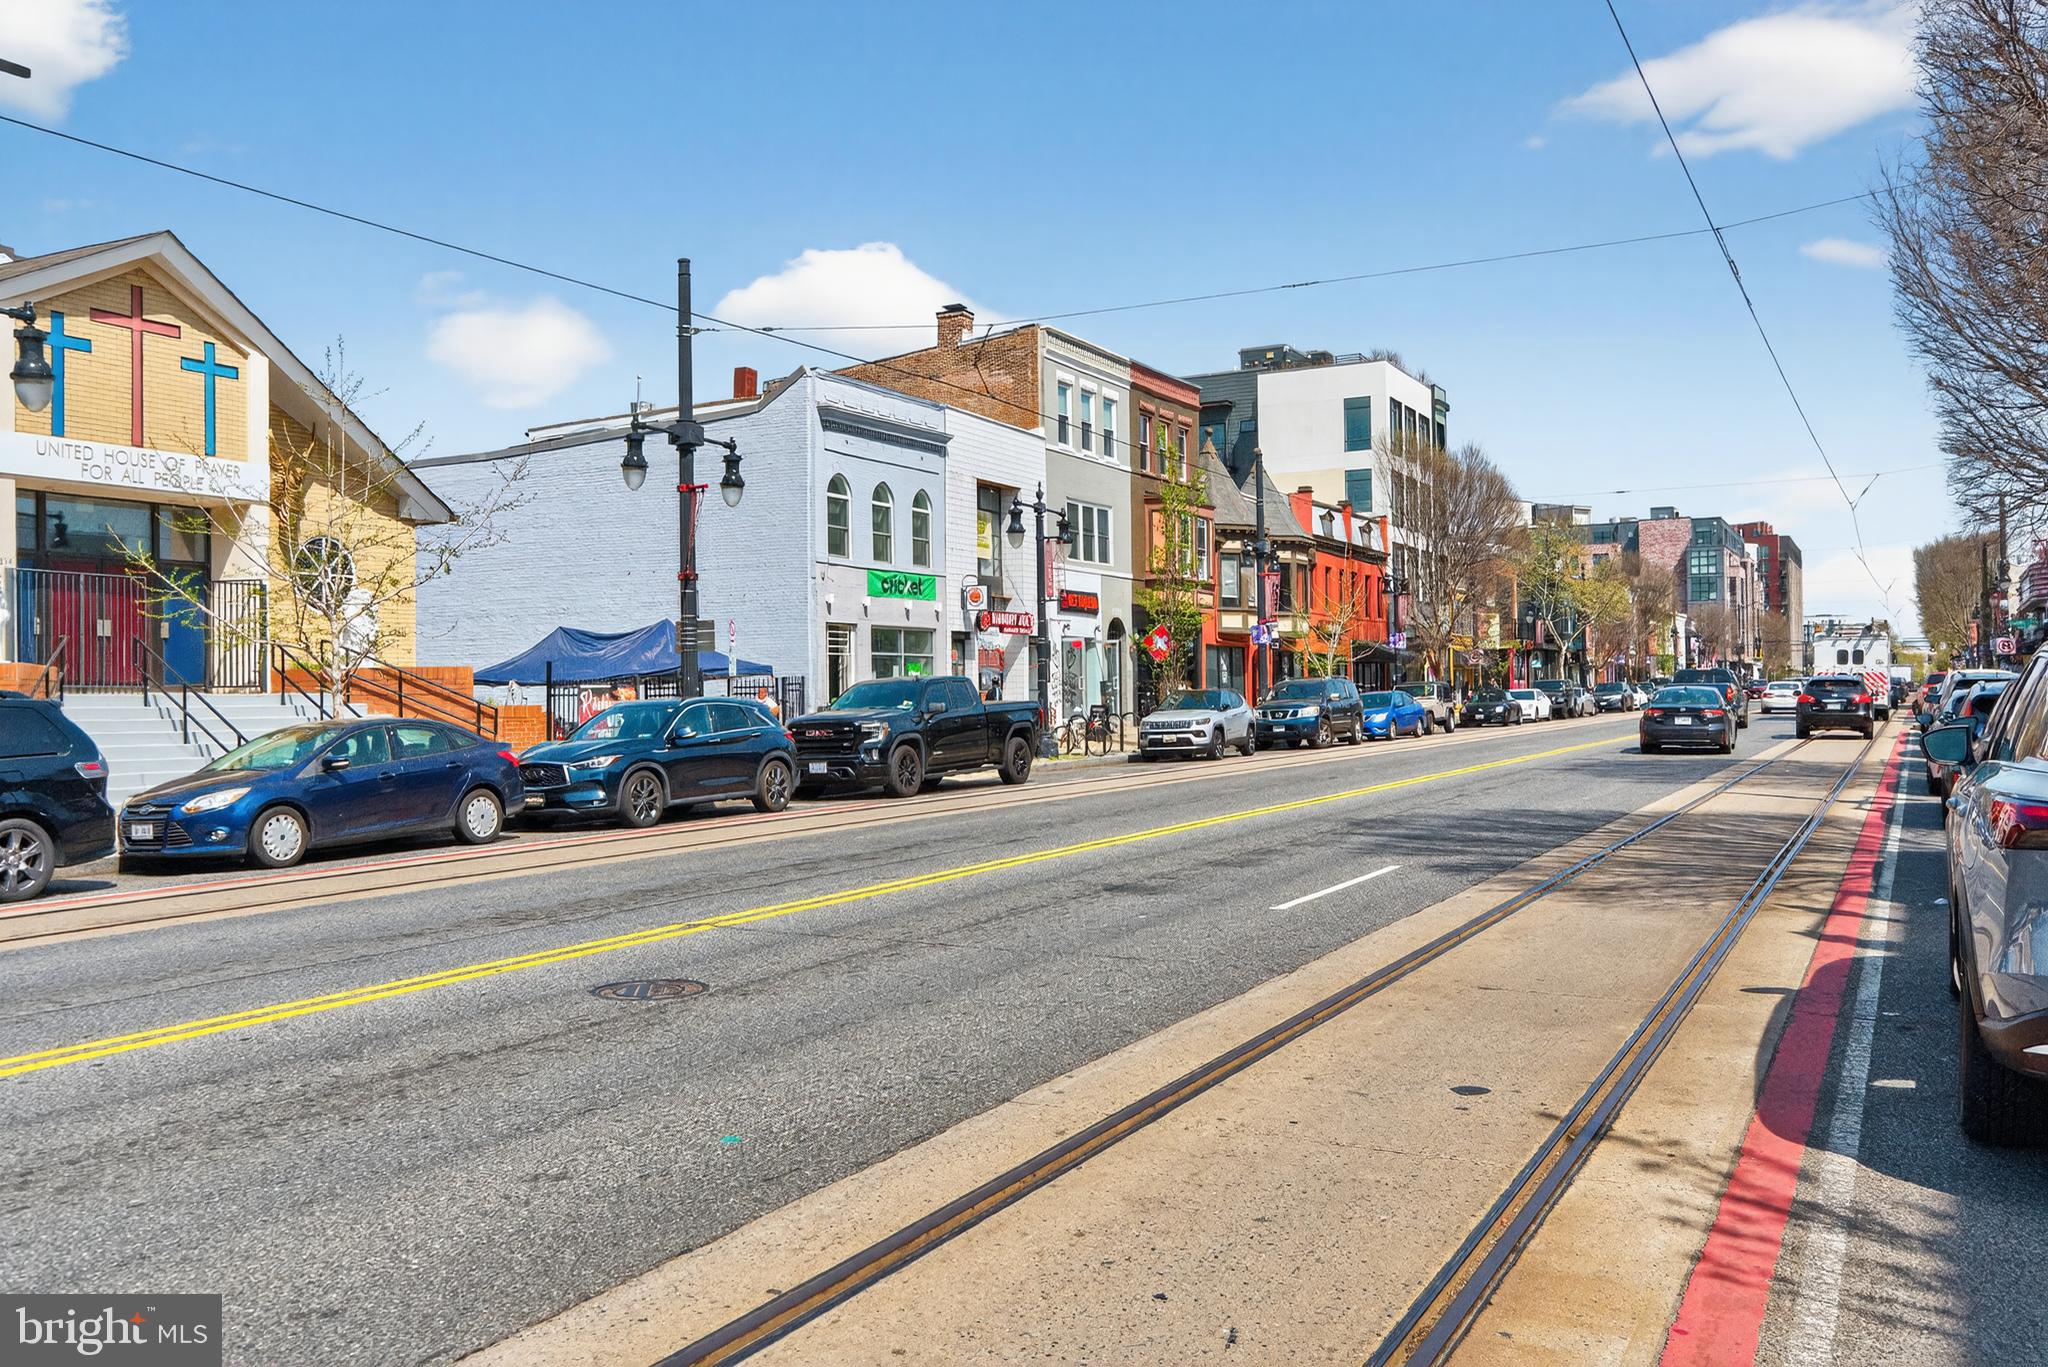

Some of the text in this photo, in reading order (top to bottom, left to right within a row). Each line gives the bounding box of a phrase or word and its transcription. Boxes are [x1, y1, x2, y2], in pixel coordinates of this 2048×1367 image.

[36, 439, 241, 479] UNITED HOUSE OF PRAYER
[81, 463, 205, 491] FOR ALL PEOPLE
[881, 574, 923, 596] cricket
